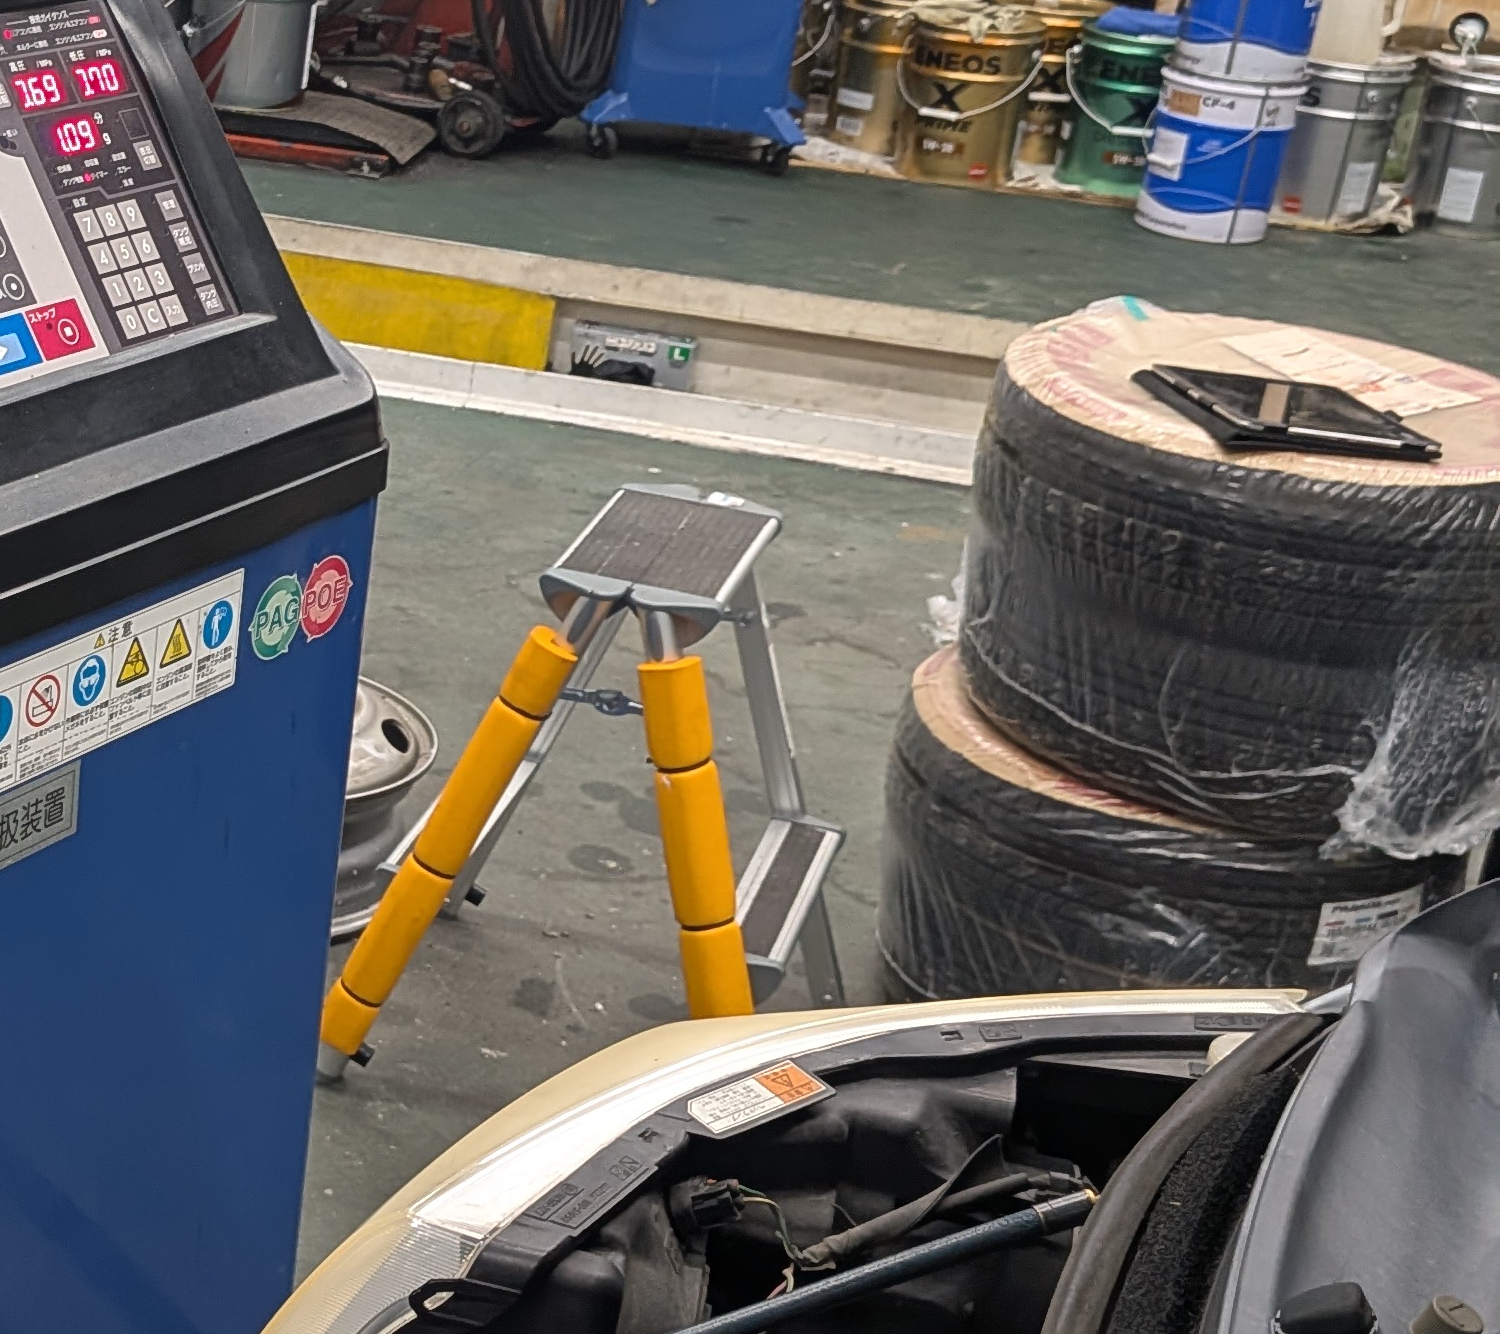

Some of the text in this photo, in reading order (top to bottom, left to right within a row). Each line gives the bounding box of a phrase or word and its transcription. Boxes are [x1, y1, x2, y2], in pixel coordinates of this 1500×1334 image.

[913, 45, 1003, 76] ENEOS
[932, 82, 972, 113] X
[102, 133, 112, 145] g
[82, 207, 137, 233] 7 8 9
[99, 239, 152, 266] 4 5 6
[112, 271, 166, 297] 1 2 3
[28, 307, 56, 323] ストップ
[126, 315, 137, 330] 0
[148, 309, 159, 324] C
[302, 576, 346, 621] POE
[255, 595, 300, 641] PAG
[108, 619, 134, 644] 注意
